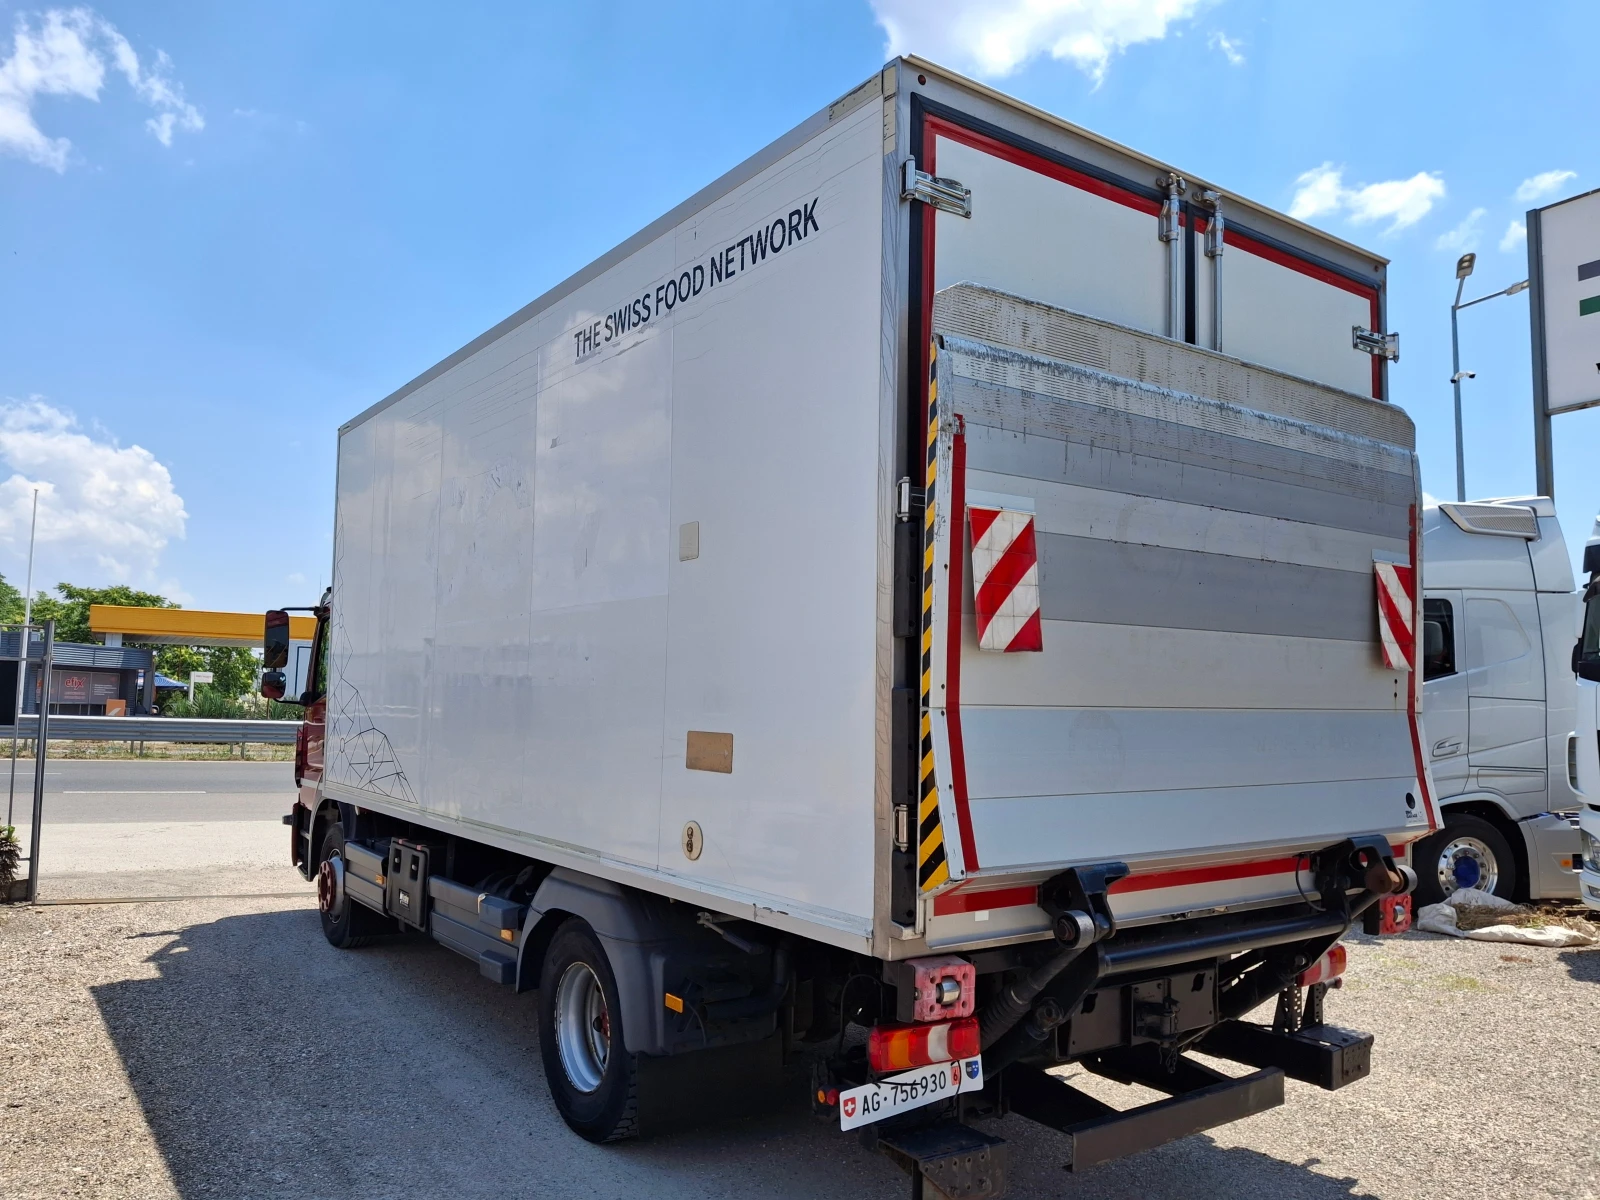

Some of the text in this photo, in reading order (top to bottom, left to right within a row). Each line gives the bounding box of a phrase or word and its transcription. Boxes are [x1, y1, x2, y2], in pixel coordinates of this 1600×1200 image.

[574, 196, 819, 358] THE SWISS FOOD NETWORK
